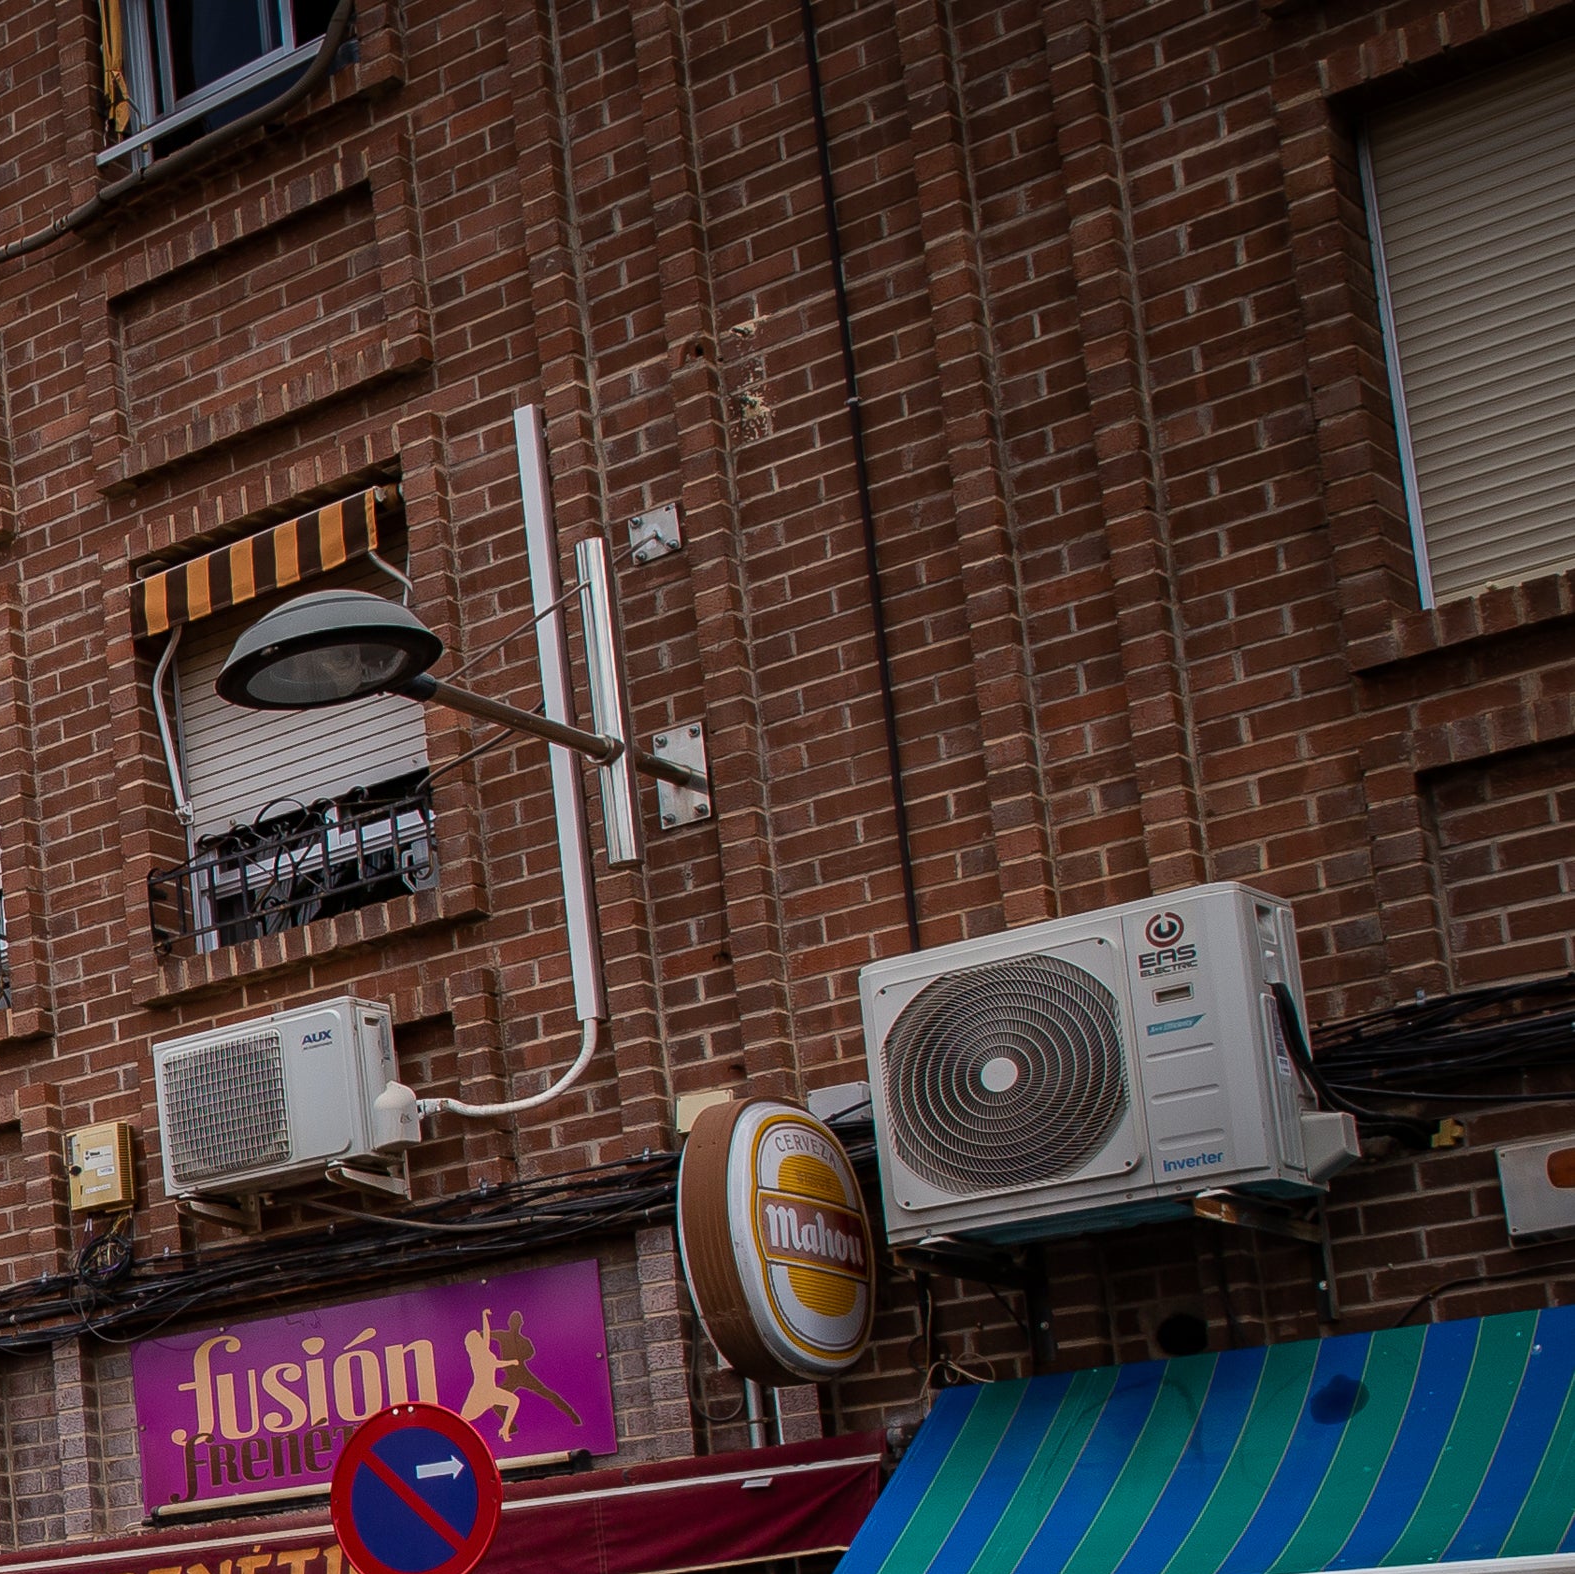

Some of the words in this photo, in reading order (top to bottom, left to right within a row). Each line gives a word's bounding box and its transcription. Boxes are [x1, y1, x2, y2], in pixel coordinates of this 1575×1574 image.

[1138, 944, 1197, 969] EAS
[1140, 960, 1198, 978] ELECTRIC
[302, 1029, 332, 1045] AUX
[775, 1134, 840, 1169] CERVEZA
[1163, 1152, 1224, 1172] Inverter
[765, 1204, 864, 1267] Mahou
[171, 1327, 438, 1446] fusión
[170, 1417, 354, 1503] frené
